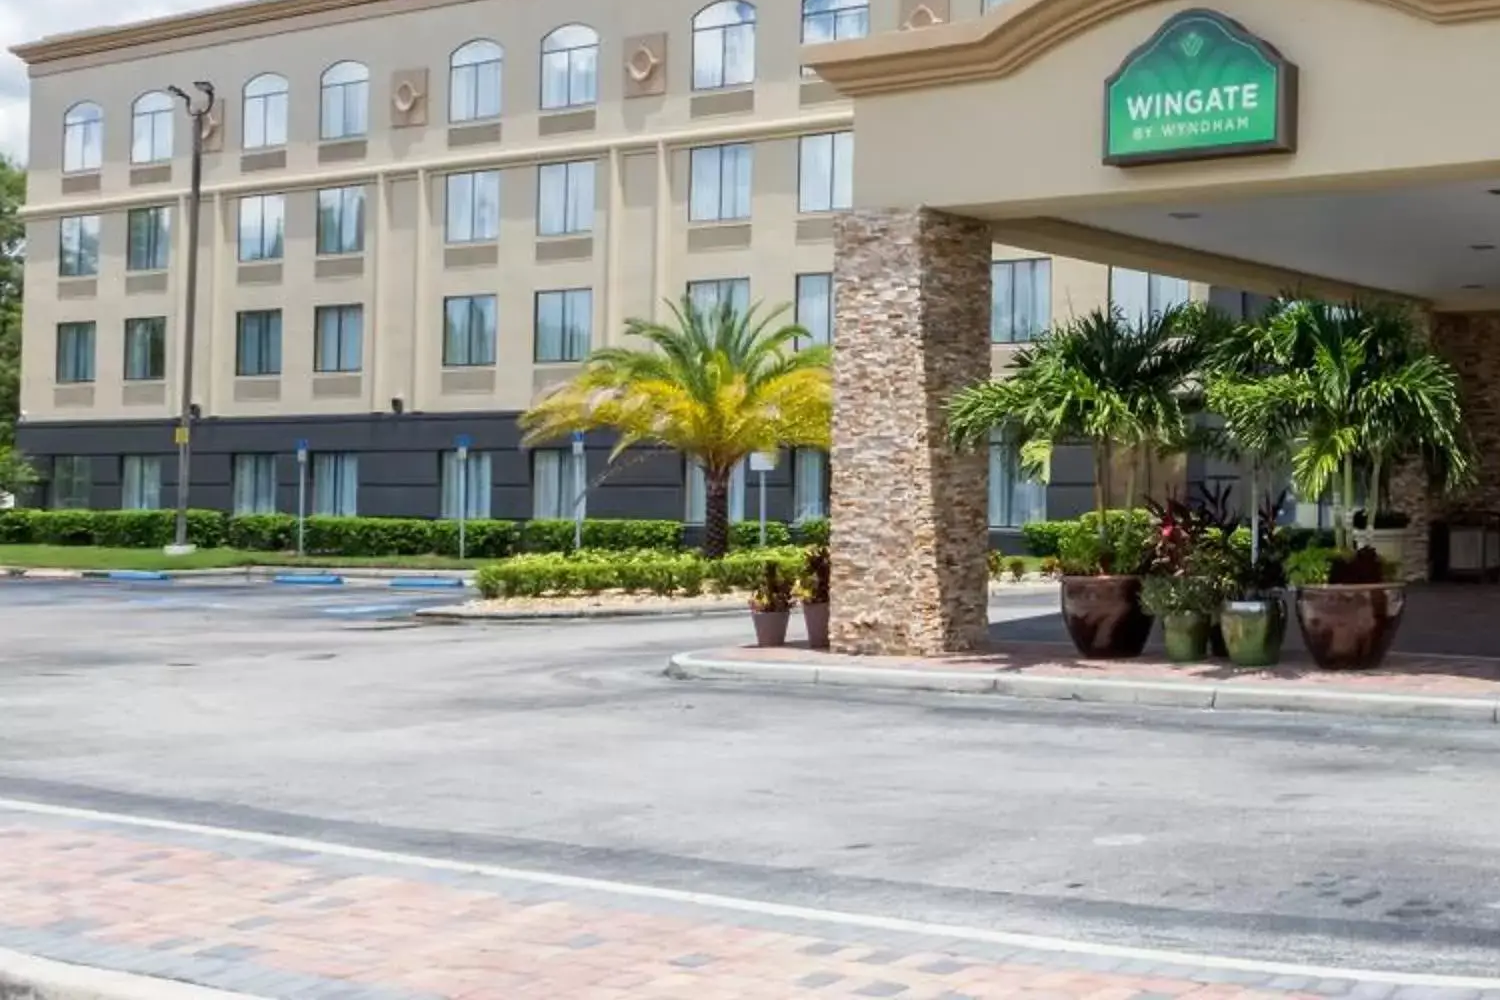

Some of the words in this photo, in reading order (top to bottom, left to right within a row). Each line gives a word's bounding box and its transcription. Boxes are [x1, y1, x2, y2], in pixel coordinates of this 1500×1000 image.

[1127, 83, 1258, 120] WINGATE
[1132, 125, 1153, 141] BY
[1162, 116, 1249, 137] WYNDHAM
